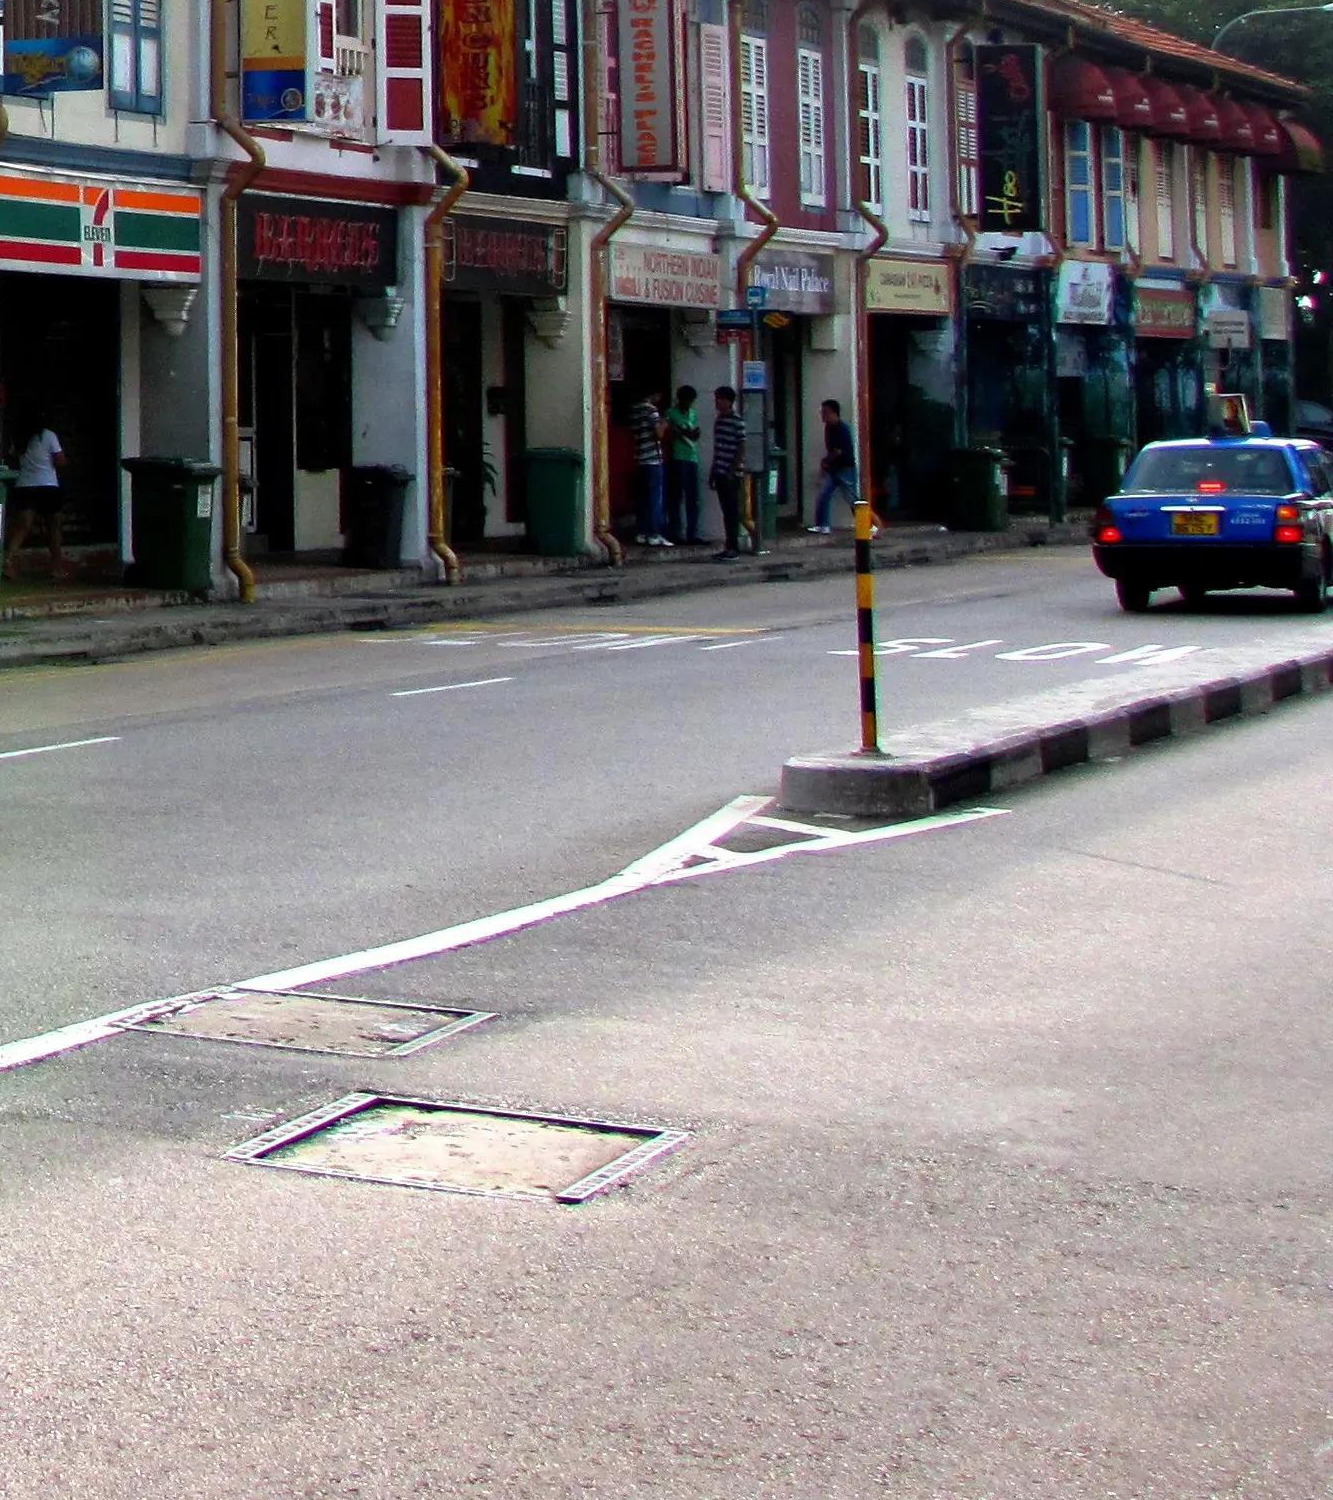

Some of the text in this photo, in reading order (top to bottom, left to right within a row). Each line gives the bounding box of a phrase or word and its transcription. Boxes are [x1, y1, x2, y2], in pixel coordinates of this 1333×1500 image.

[643, 252, 689, 277] NORTHERN
[690, 256, 719, 280] INDIAN
[652, 279, 683, 301] FUSION
[685, 281, 718, 304] CUISINE
[827, 638, 1202, 666] SLOW
